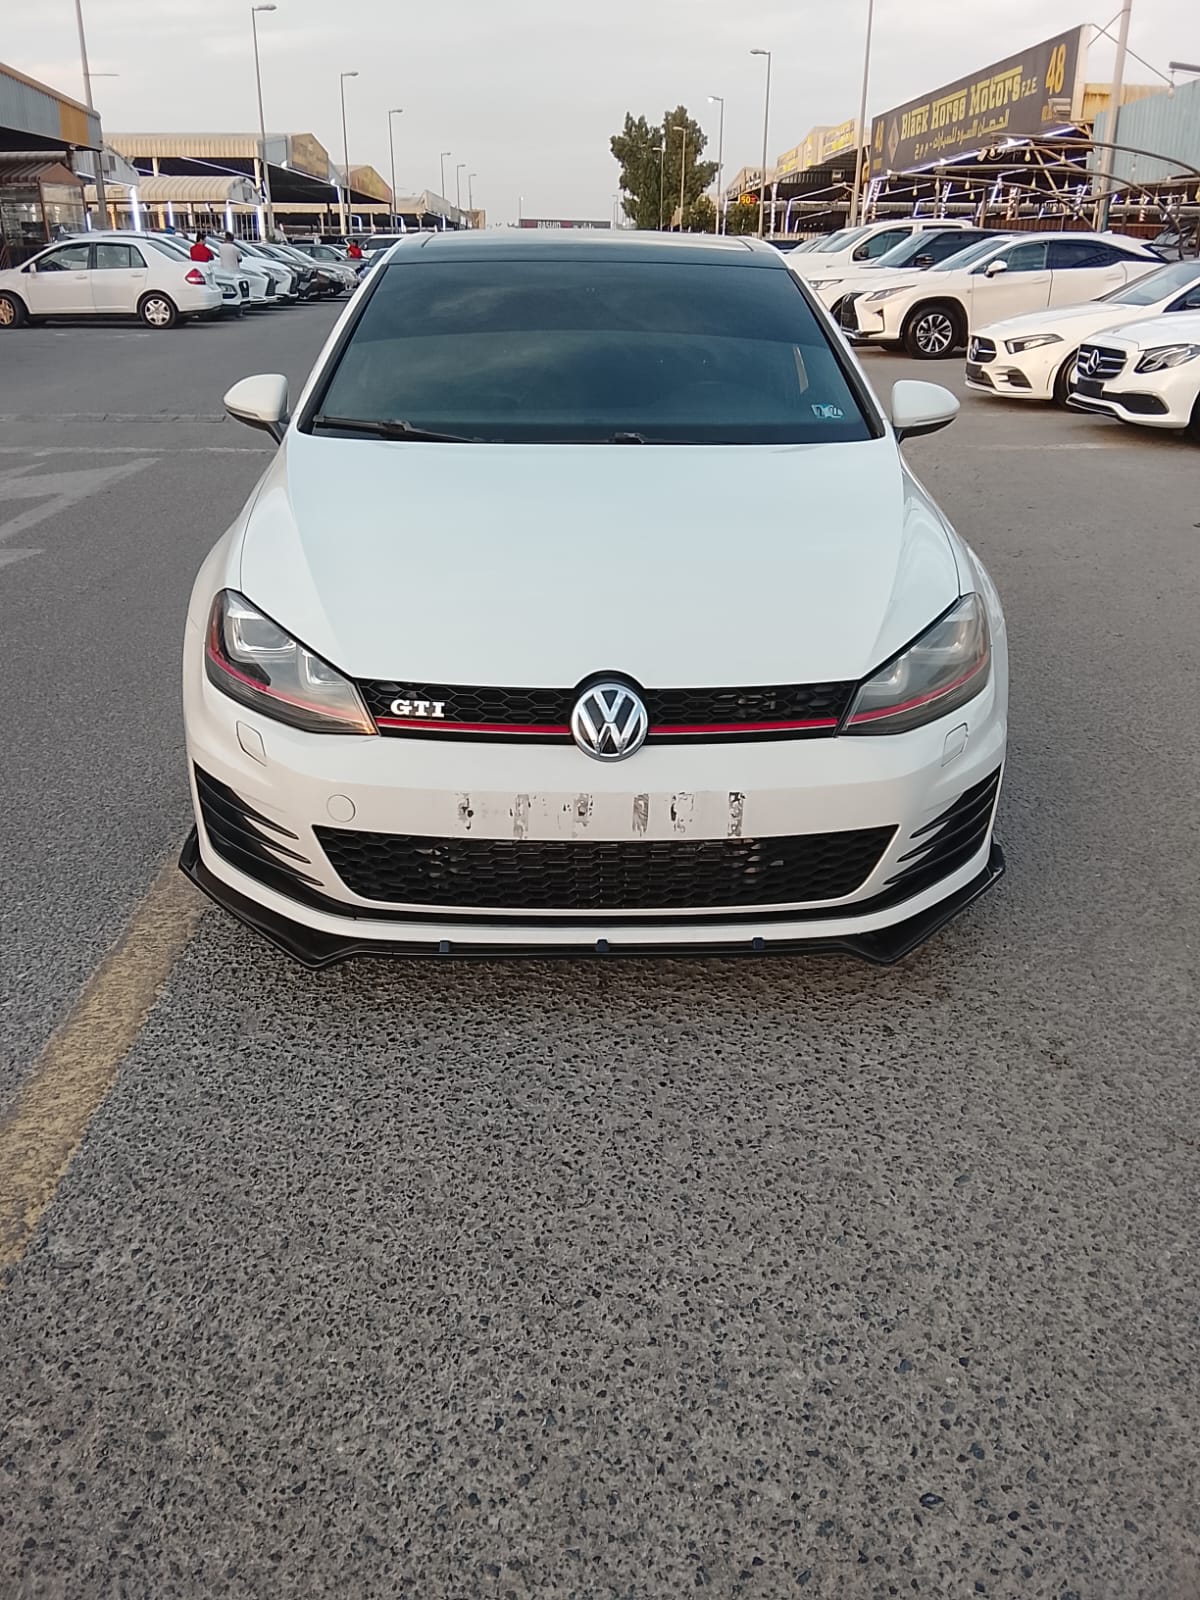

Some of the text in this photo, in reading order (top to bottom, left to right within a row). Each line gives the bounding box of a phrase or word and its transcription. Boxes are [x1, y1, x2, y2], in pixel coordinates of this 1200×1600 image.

[1045, 43, 1067, 96] 48
[901, 103, 930, 141] Black
[930, 88, 968, 131] Horse
[968, 65, 1024, 117] Motors
[390, 699, 446, 718] GTI
[573, 685, 647, 761] VW
